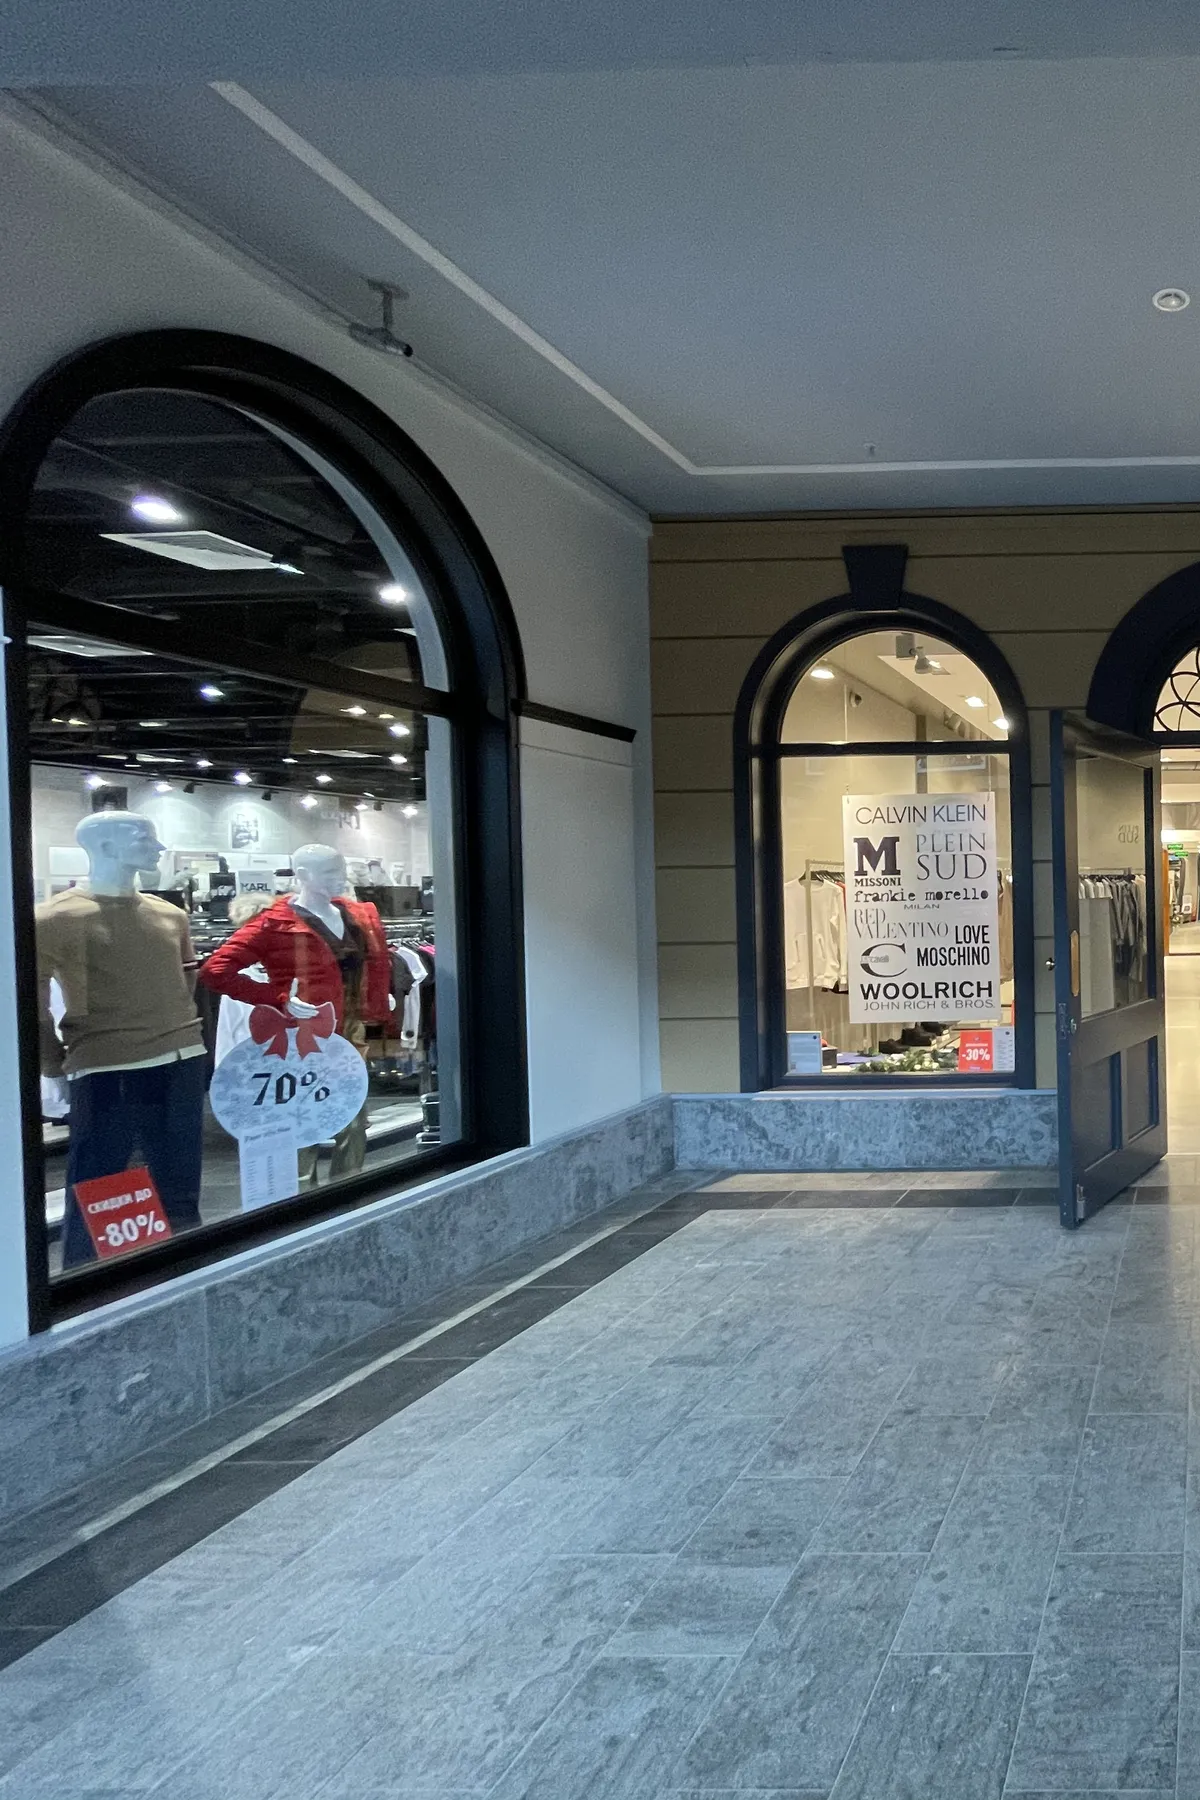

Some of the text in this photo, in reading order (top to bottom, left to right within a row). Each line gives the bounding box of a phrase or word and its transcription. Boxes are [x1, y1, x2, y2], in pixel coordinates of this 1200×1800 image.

[855, 804, 986, 824] CALVIN KLEIN
[916, 833, 986, 853] PLEIN
[917, 853, 987, 880] SUD
[240, 882, 272, 892] KARL
[854, 877, 901, 887] MISSONI
[854, 888, 989, 903] frankie morello
[854, 908, 886, 924] RED
[854, 922, 949, 938] VALENTINO
[955, 925, 990, 944] LOVE
[917, 946, 990, 966] MOSCHINO
[860, 981, 993, 1000] WOOLRICH
[864, 999, 996, 1011] JOHN RICH & BROS.
[962, 1048, 991, 1061] -30%
[252, 1069, 331, 1106] 70%
[98, 1211, 166, 1247] -80%
